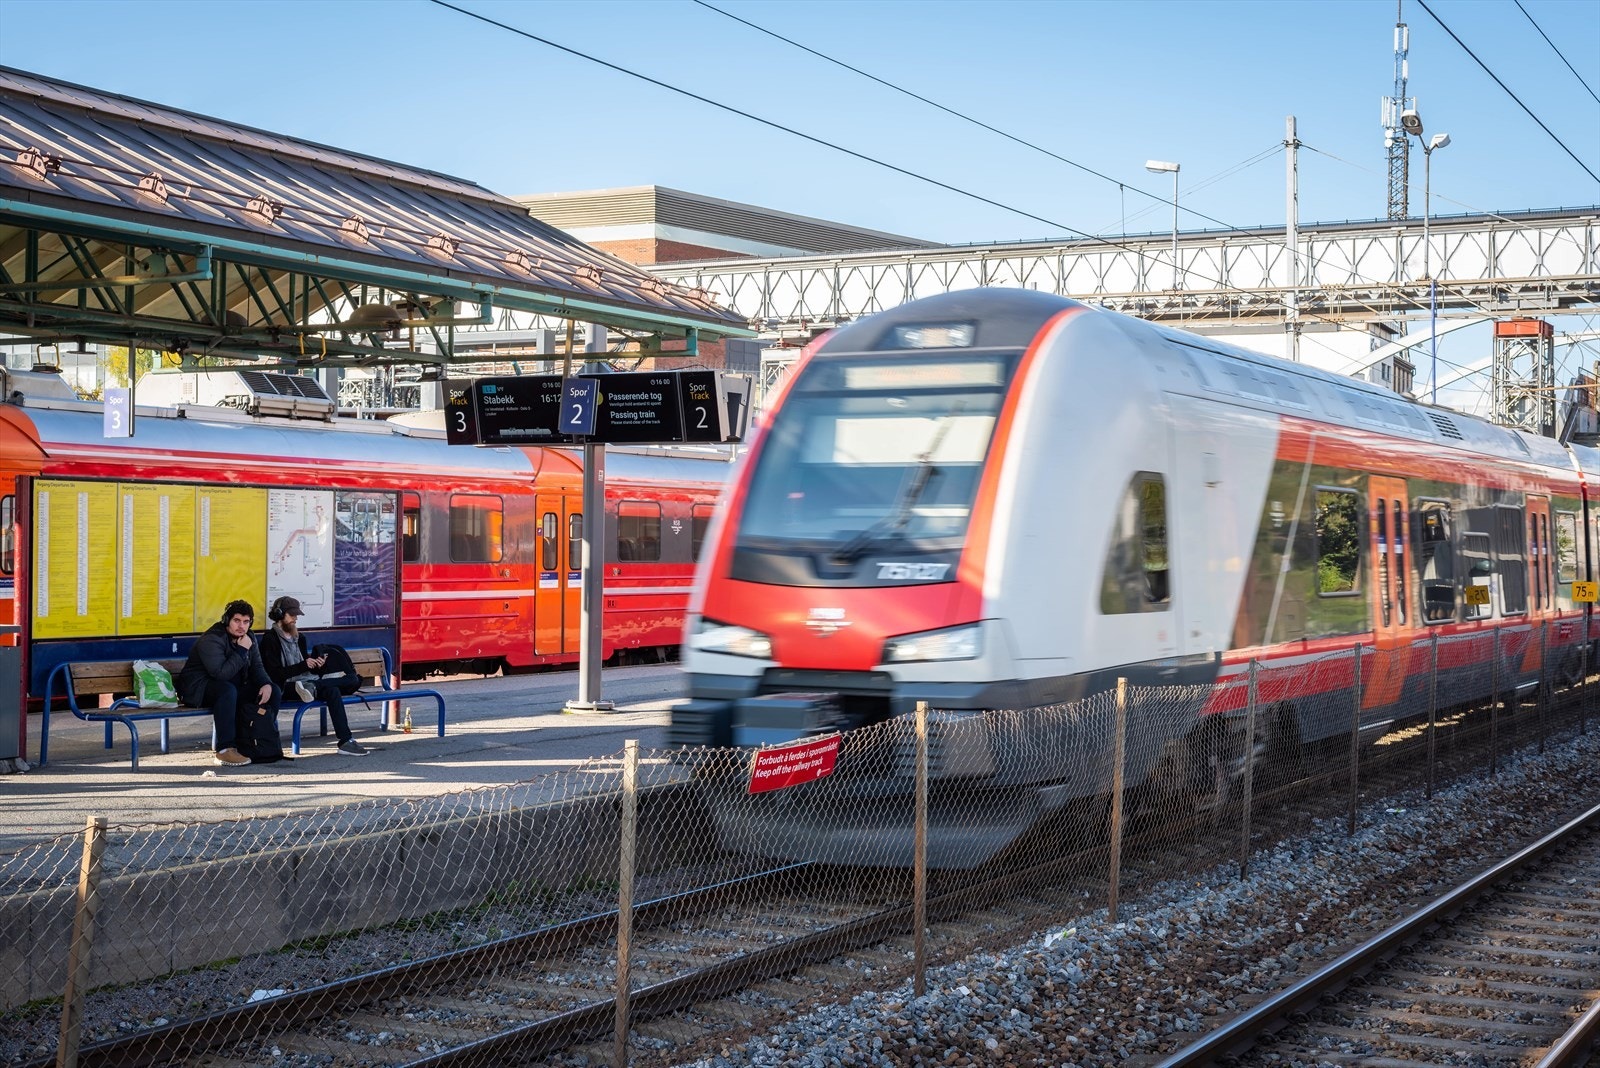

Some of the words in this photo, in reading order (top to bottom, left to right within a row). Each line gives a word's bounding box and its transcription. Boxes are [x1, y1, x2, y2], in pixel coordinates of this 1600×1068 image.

[689, 383, 706, 392] Spor
[450, 389, 464, 398] Spor
[570, 388, 587, 398] Spor
[608, 392, 648, 400] Passerende
[650, 392, 662, 401] tog
[690, 392, 710, 400] Track
[110, 396, 122, 405] Spor
[450, 397, 468, 406] Track
[484, 395, 515, 404] Stabekk
[570, 404, 582, 424] 2
[610, 410, 638, 420] Passing
[639, 410, 655, 418] train
[696, 407, 708, 428] 2
[112, 411, 121, 429] 3
[455, 412, 467, 432] 3
[1576, 586, 1586, 597] 75
[758, 755, 784, 766] Forbudt
[789, 751, 806, 761] ferdes
[755, 768, 772, 779] Keep
[772, 766, 782, 776] off
[782, 765, 792, 774] the
[792, 761, 810, 772] railway
[811, 756, 823, 766] track
